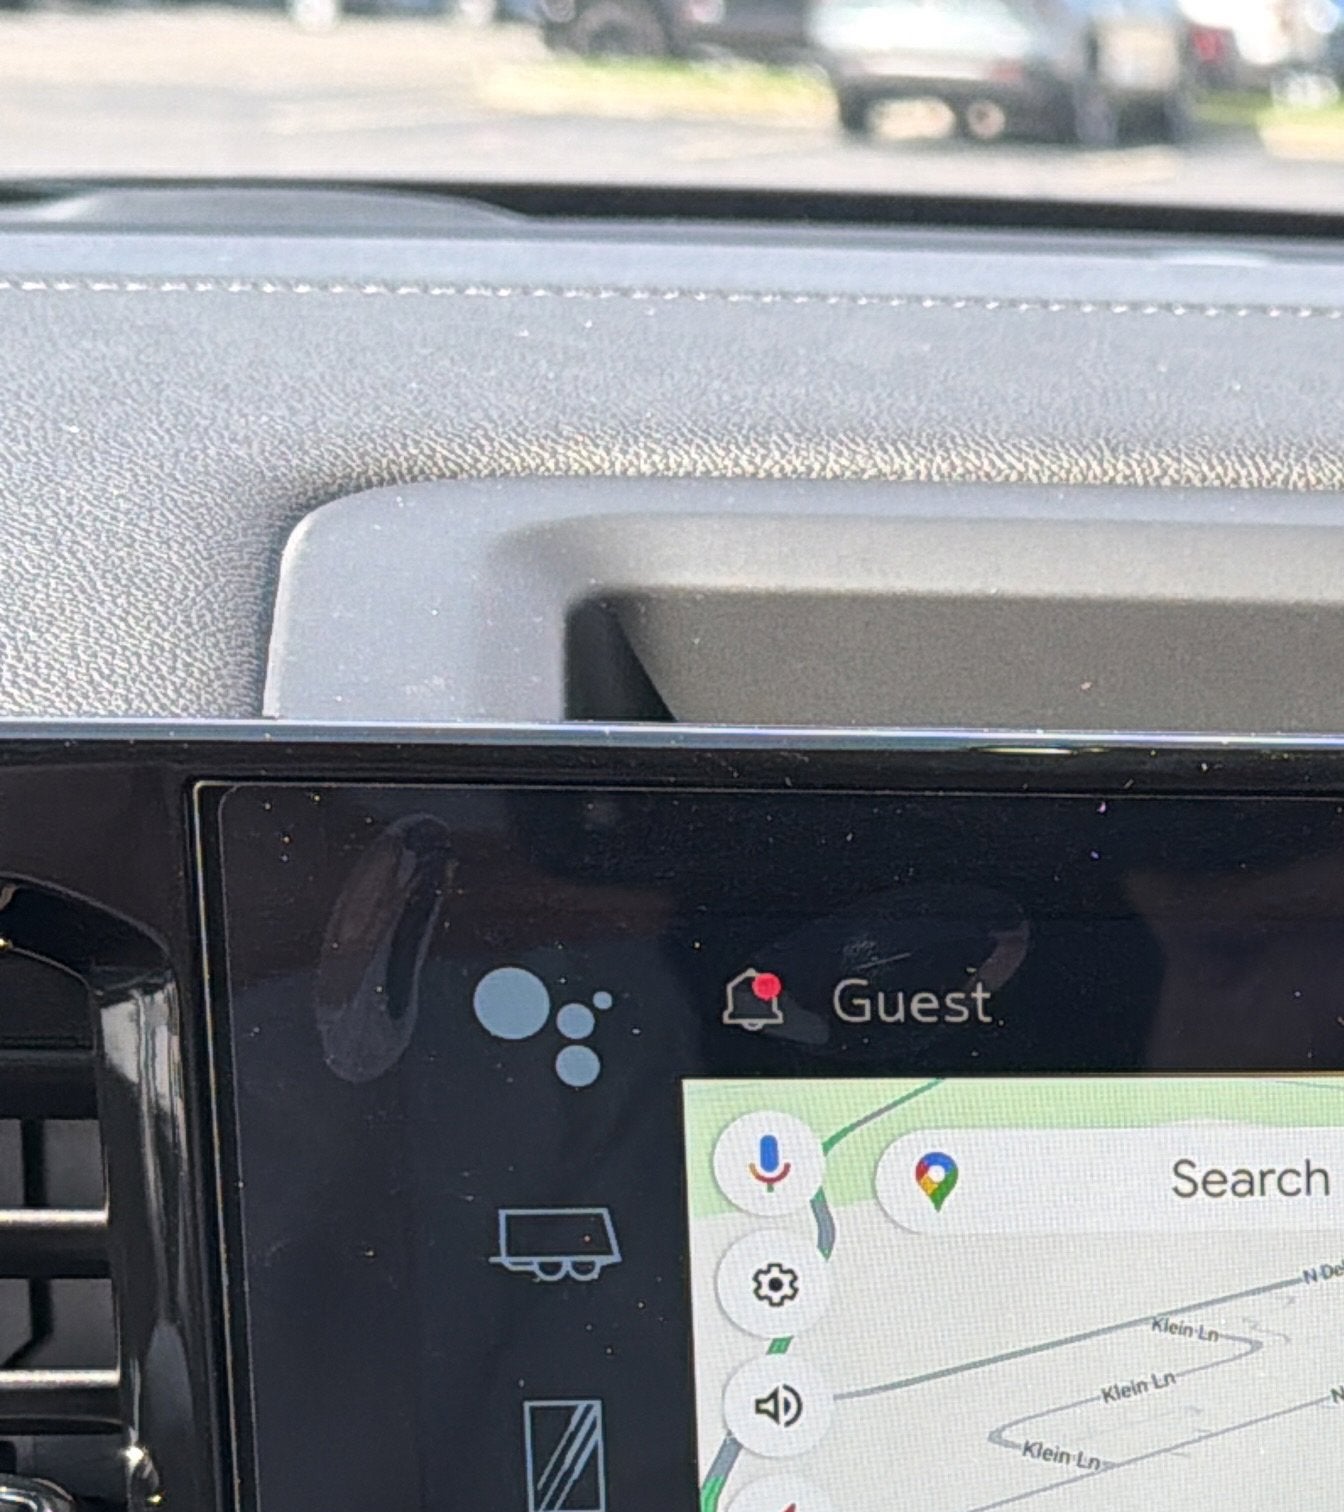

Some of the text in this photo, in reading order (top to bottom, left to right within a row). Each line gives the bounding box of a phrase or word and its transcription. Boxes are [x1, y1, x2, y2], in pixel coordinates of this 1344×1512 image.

[832, 978, 992, 1024] Guest
[1171, 1157, 1331, 1200] Search
[1303, 1269, 1318, 1285] N
[1150, 1316, 1221, 1344] Klein Ln
[1101, 1369, 1177, 1405] Klein Ln
[1021, 1440, 1102, 1471] Klein Ln
